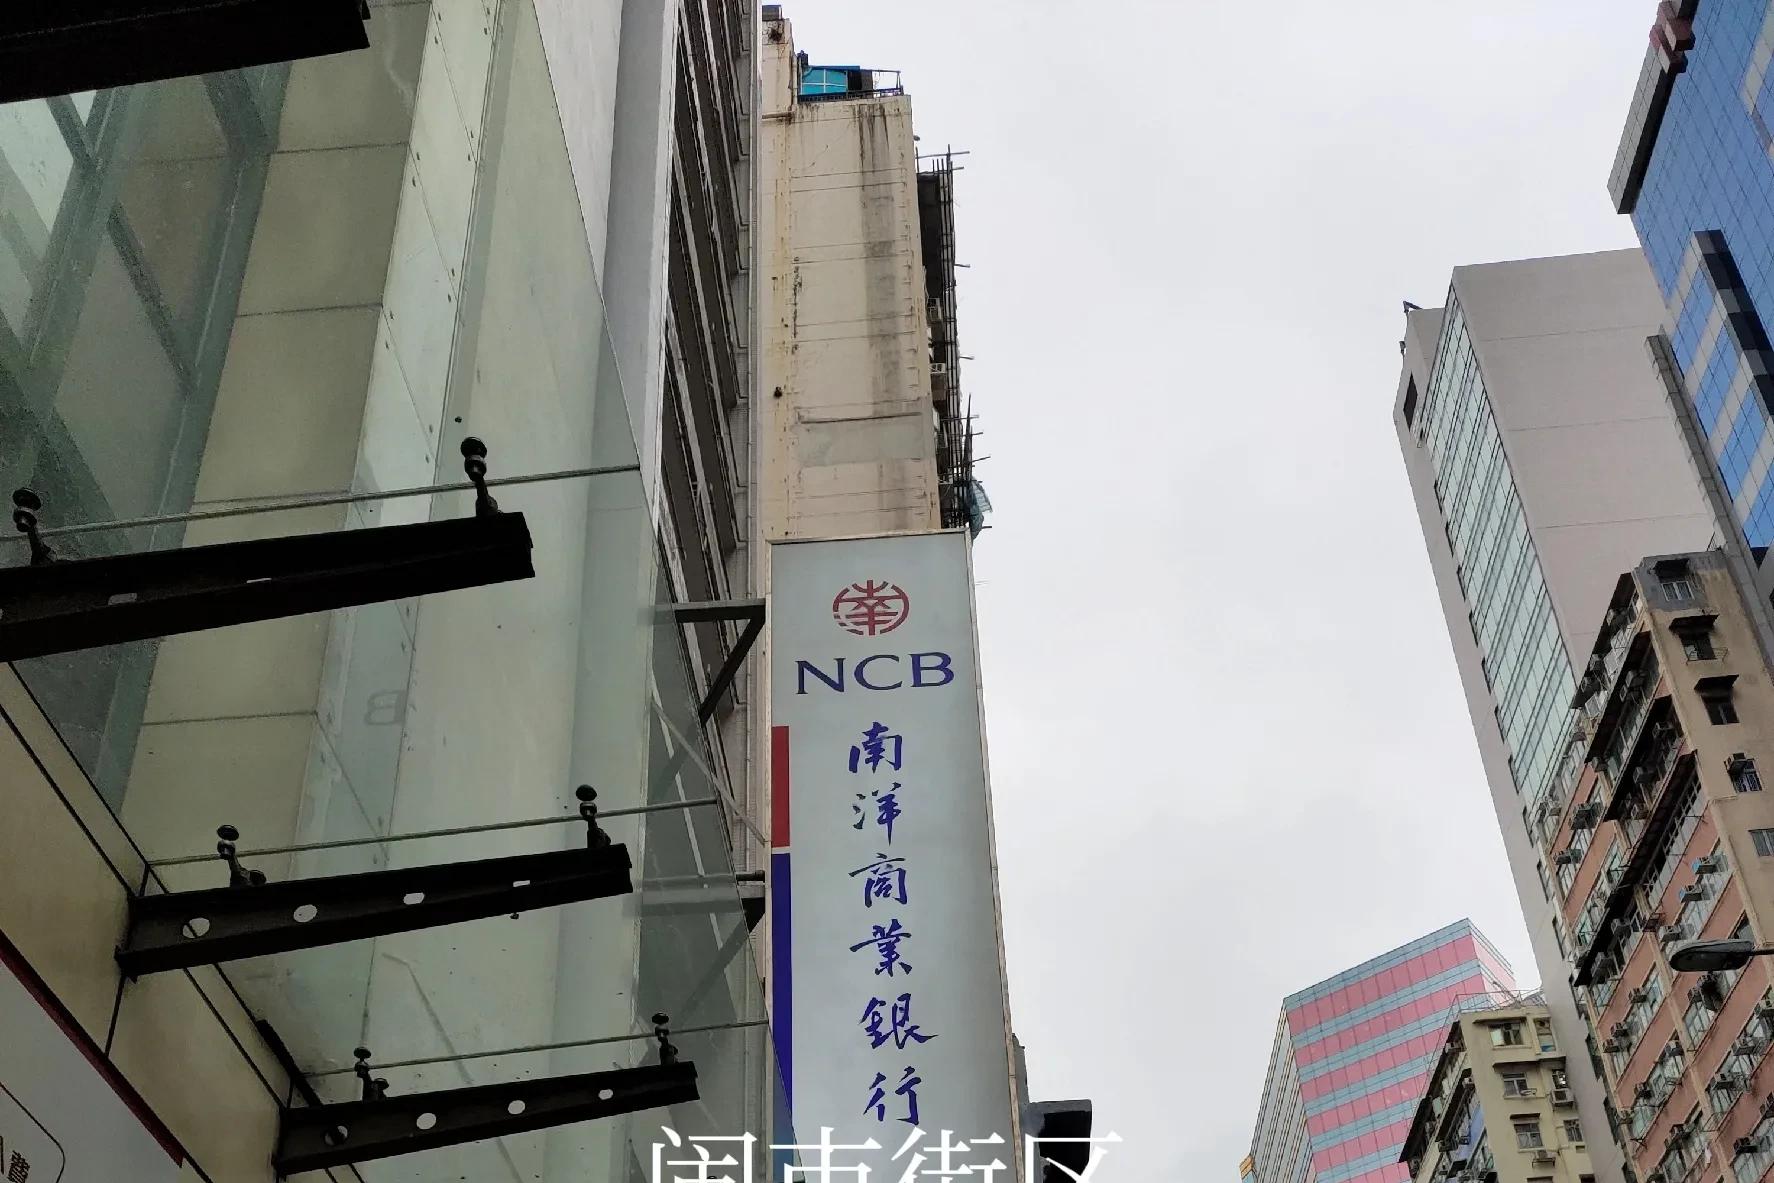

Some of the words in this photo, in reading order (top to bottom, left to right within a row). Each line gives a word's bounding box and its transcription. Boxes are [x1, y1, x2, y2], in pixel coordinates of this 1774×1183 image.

[794, 651, 954, 695] NCB
[848, 721, 938, 1126] 南洋商業銀行
